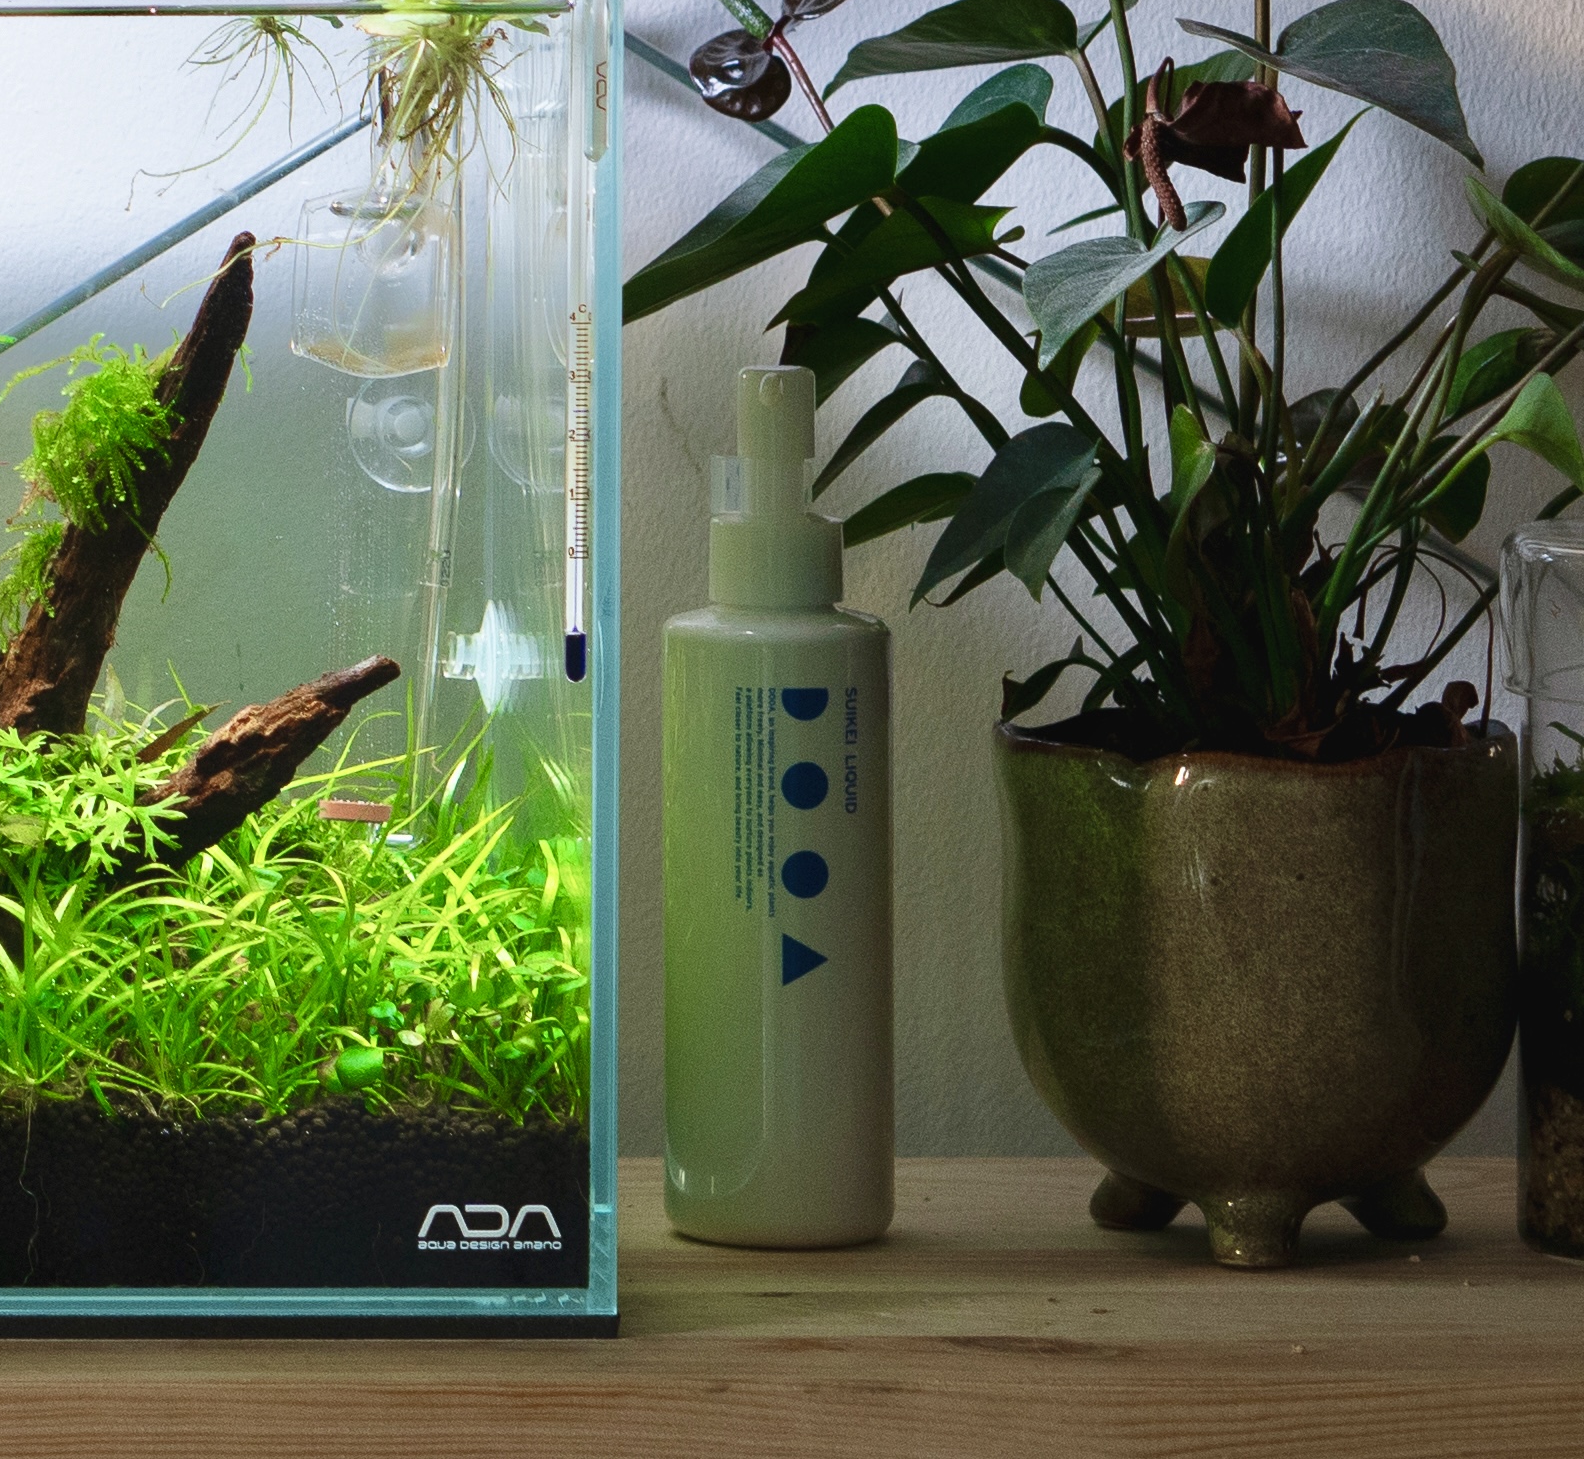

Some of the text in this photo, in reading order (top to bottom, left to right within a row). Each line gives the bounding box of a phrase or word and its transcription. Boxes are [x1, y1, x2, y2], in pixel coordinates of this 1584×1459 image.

[596, 60, 607, 112] ADA
[845, 687, 857, 813] SUIKEI LIQUID
[417, 1203, 562, 1239] ADA
